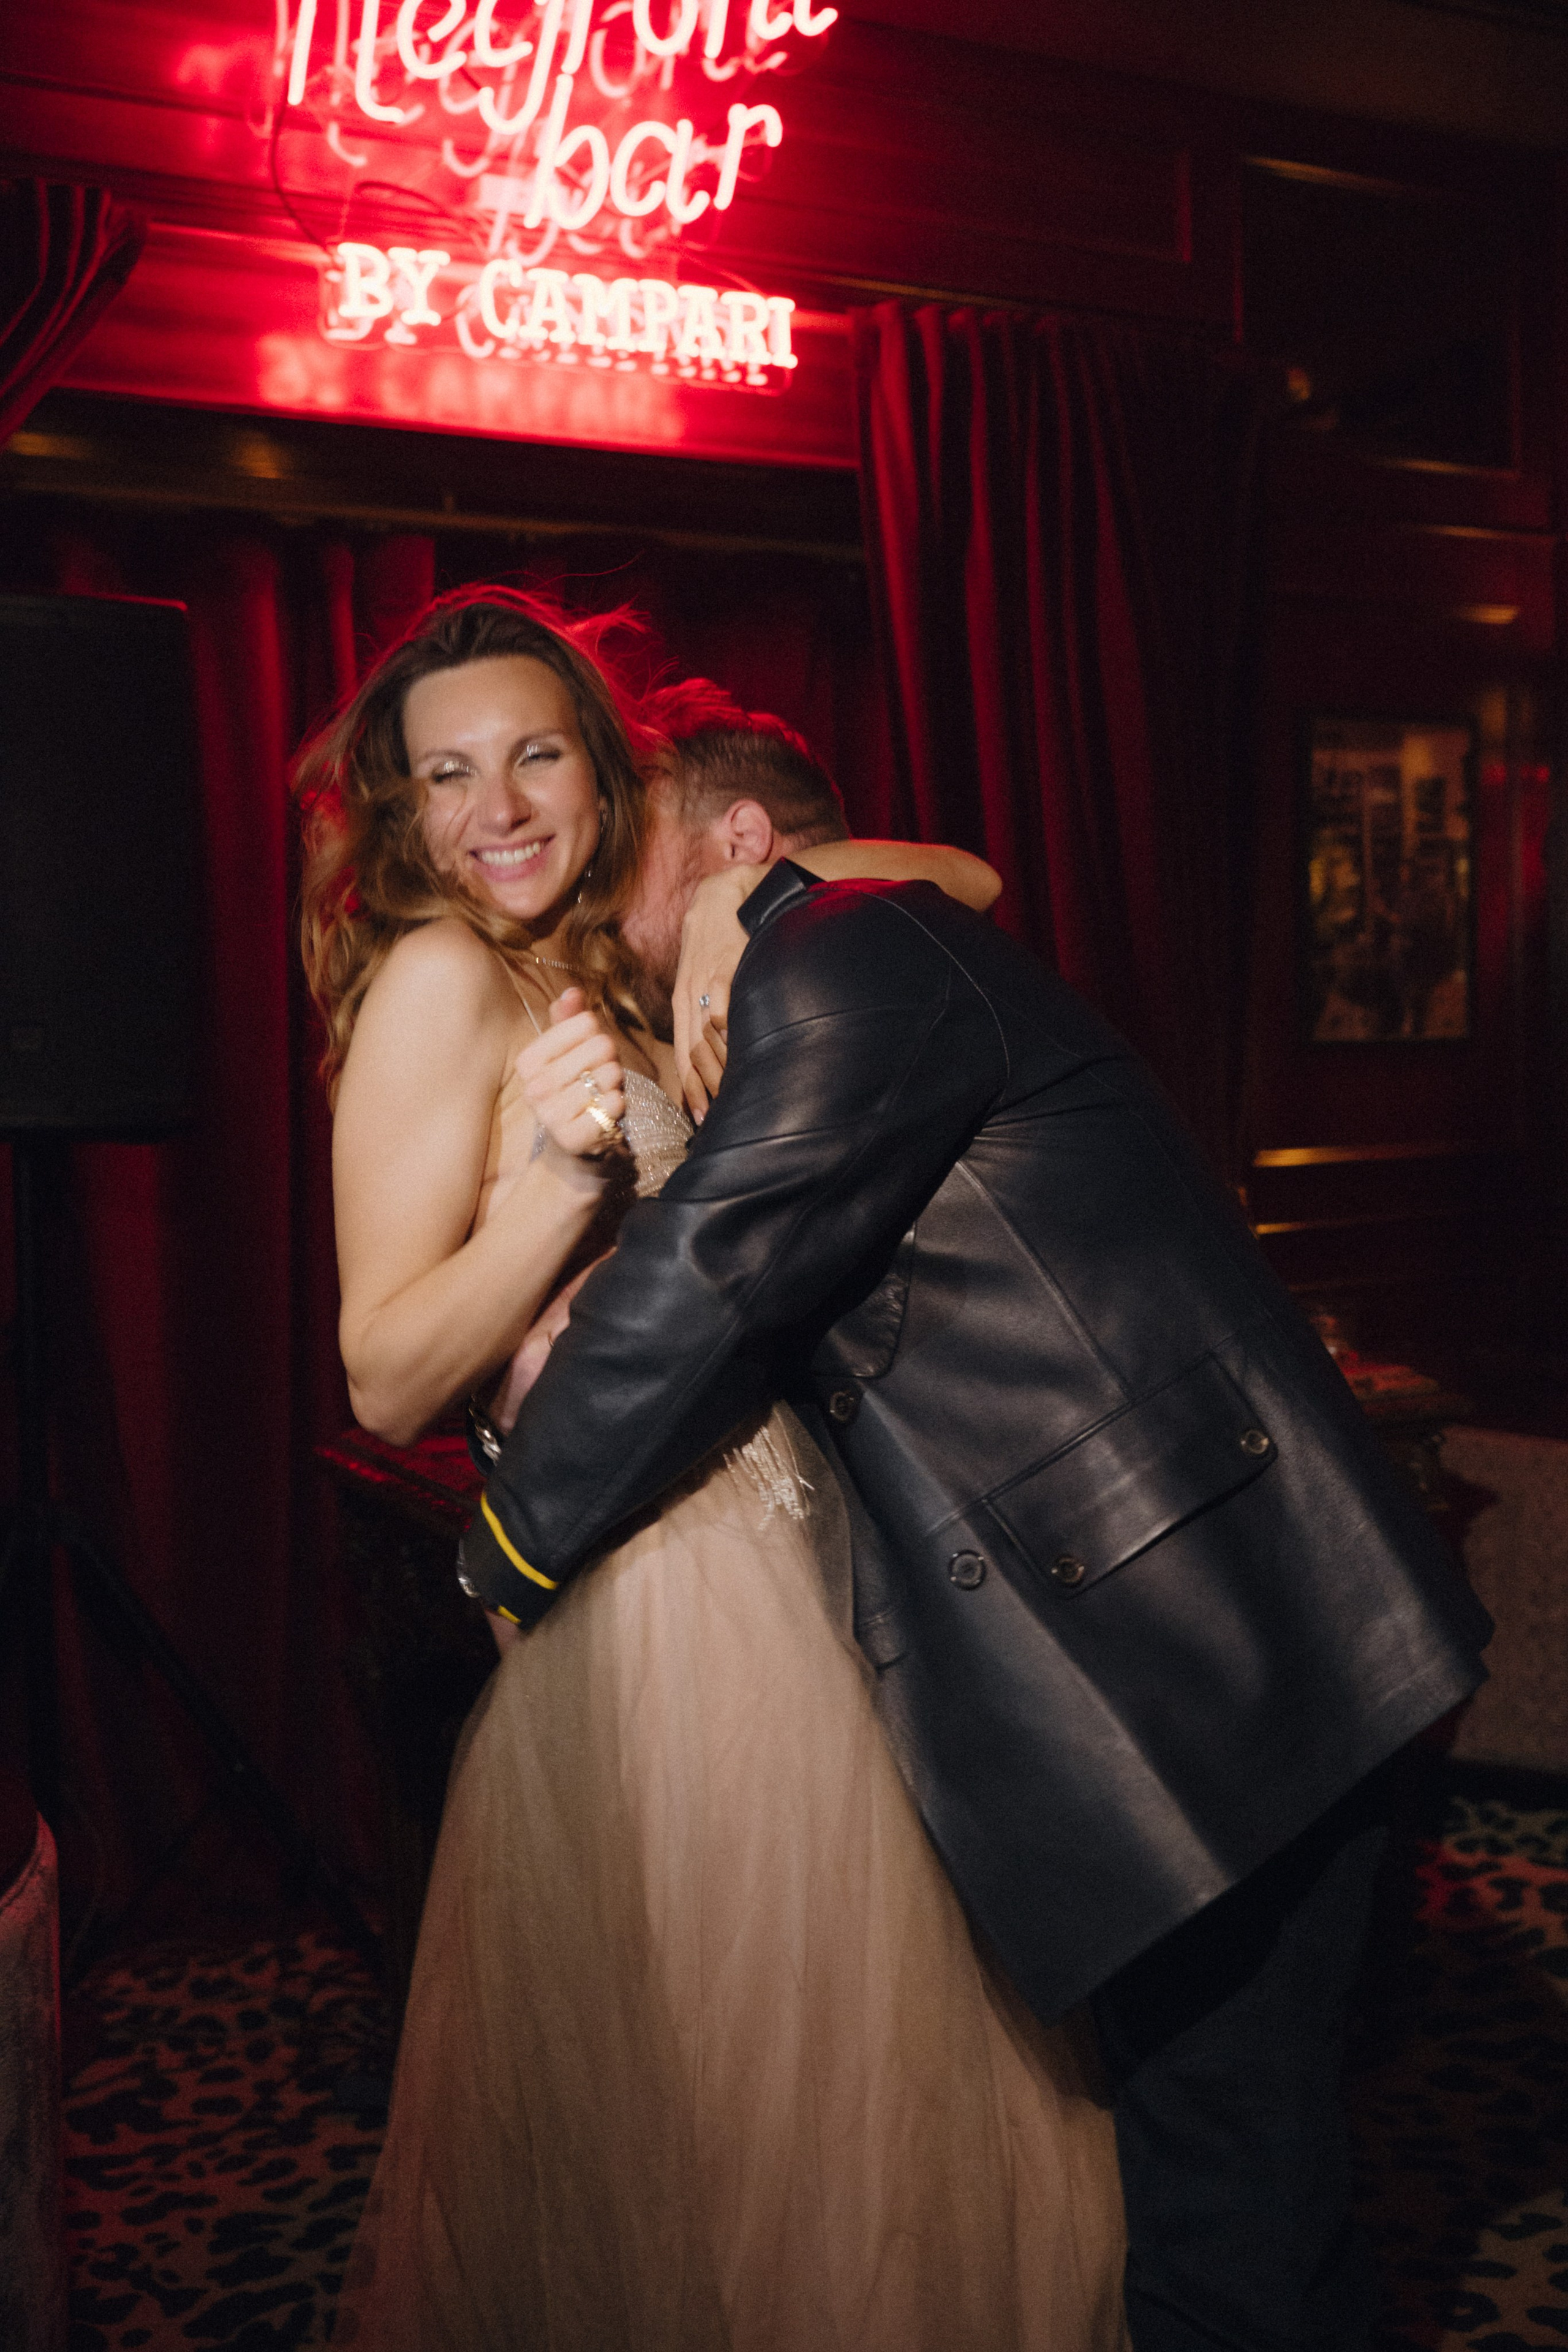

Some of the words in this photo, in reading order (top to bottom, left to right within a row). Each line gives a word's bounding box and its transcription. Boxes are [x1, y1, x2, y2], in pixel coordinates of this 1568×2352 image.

[524, 74, 783, 228] bar
[337, 243, 450, 326] BY
[479, 259, 798, 368] CAMPARI
